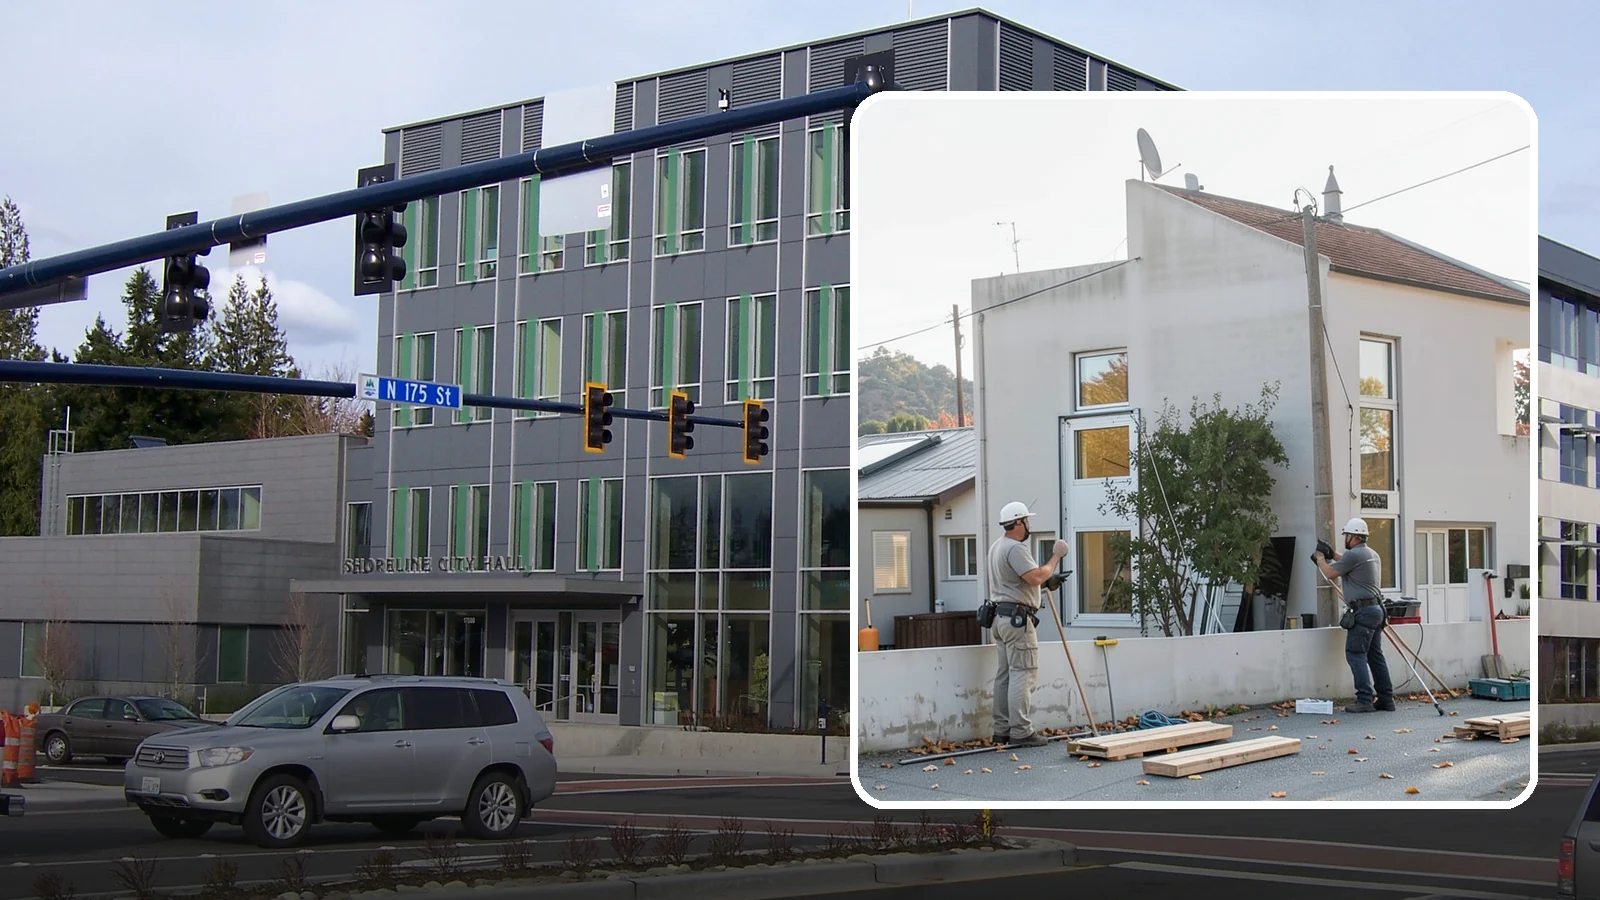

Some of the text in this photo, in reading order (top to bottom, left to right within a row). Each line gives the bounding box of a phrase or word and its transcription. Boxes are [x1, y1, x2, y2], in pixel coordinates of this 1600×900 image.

[387, 380, 451, 406] N 175 St
[343, 556, 525, 574] SHORELINE CITY HALL
